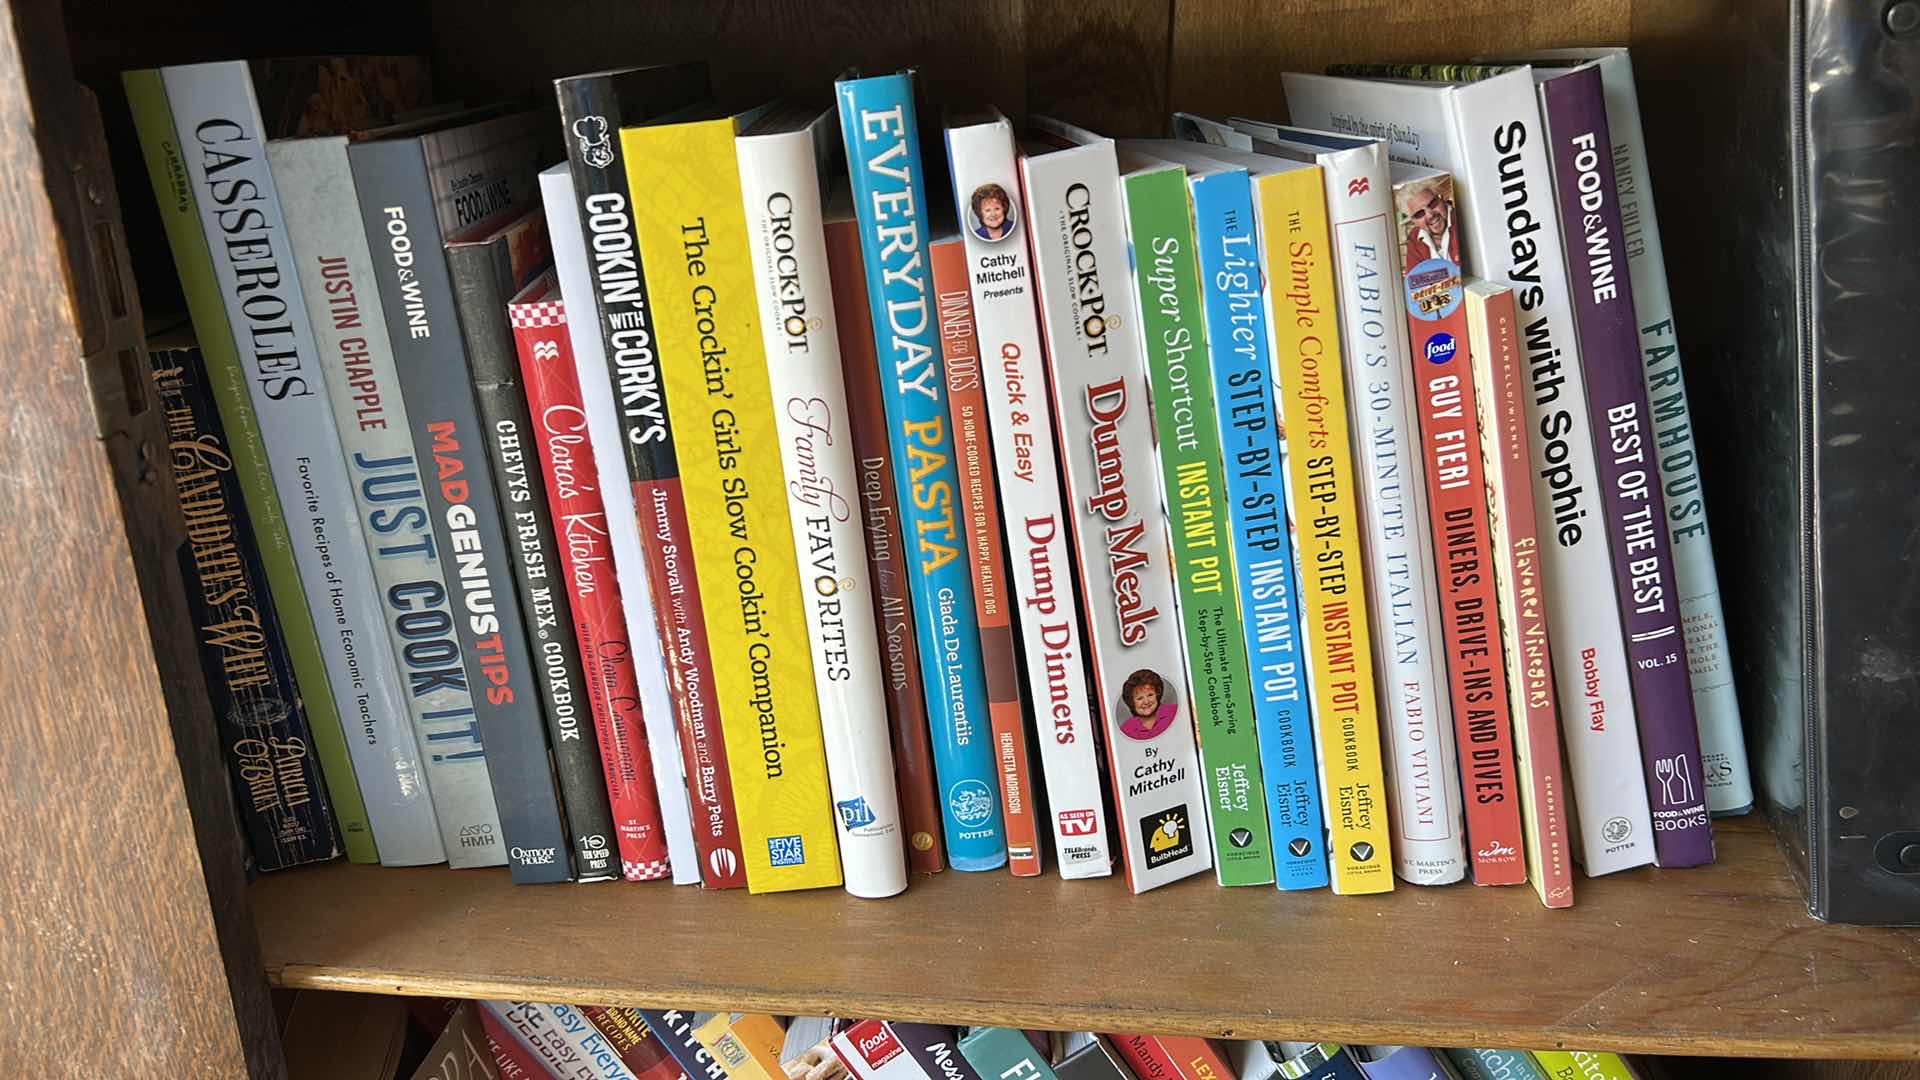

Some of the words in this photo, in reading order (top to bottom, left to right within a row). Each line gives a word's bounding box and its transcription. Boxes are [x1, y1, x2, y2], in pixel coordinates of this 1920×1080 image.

[1358, 117, 1368, 134] the
[1368, 120, 1385, 137] spirit
[1386, 123, 1394, 144] of
[1393, 122, 1420, 149] Sunday
[1613, 144, 1636, 196] NANCY
[1224, 209, 1238, 233] THE
[1287, 211, 1302, 233] THE
[1494, 120, 1545, 312] Sundays
[1572, 132, 1617, 304] FOOD&WINE
[1621, 201, 1645, 259] FULLER
[195, 118, 315, 401] CASSEROLES
[585, 193, 644, 309] COOKIN'
[682, 217, 709, 276] The
[980, 253, 1017, 268] Cathy
[318, 256, 361, 330] JUSTIN
[976, 267, 1025, 285] Mitchell
[983, 286, 1024, 299] Presents
[1147, 237, 1181, 322] Super
[1216, 233, 1260, 361] Lighter
[1286, 241, 1320, 328] Simple
[608, 311, 645, 330] WITH
[939, 291, 973, 339] DINNER
[1354, 242, 1386, 368] FABIO'S
[692, 285, 734, 399] Crockin'
[861, 105, 937, 400] EVERYDAY
[903, 416, 960, 576] PASTA
[1426, 338, 1455, 359] food
[1524, 317, 1565, 406] with
[339, 337, 387, 431] CHAPPLE
[611, 329, 666, 444] CORKY'S
[948, 355, 979, 392] DOGS
[1002, 343, 1027, 405] Quick
[1163, 328, 1199, 452] Shortcut
[1298, 336, 1330, 449] Comforts
[1428, 375, 1463, 419] GUY
[712, 409, 741, 470] Girls
[1011, 411, 1029, 426] &
[1607, 402, 1644, 465] BEST
[1641, 318, 1705, 545] FARMHOUSE
[543, 404, 594, 499] Clara's
[788, 398, 849, 522] Family
[964, 419, 980, 477] HOME-COOKED
[1014, 433, 1034, 484] Easy
[1086, 375, 1129, 521] Dump
[1228, 369, 1280, 552] STEP-BY-STEP
[1369, 382, 1406, 540] 30-MINUTE
[1435, 429, 1470, 490] FIERI
[296, 456, 319, 513] Favorite
[862, 457, 884, 501] Deep
[970, 479, 984, 511] RECIPES
[1176, 461, 1216, 548] INSTANT
[1540, 410, 1587, 547] Sophie
[1617, 470, 1648, 500] OF
[354, 452, 437, 560] JUST
[652, 488, 672, 542] Jimmy
[722, 478, 749, 540] Slow
[1307, 456, 1346, 595] STEP-BY-STEP
[1622, 504, 1656, 555] THE
[311, 517, 332, 568] Recipes
[561, 511, 607, 598] Kitchen
[867, 507, 892, 560] Frying
[1444, 507, 1480, 593] DINERS,
[325, 571, 342, 583] of
[497, 420, 530, 503] CHEVYS
[515, 510, 547, 580] FRESH
[543, 642, 580, 742] COOKBOOK
[663, 545, 684, 595] Stovall
[980, 565, 995, 597] HEALTHY
[1025, 514, 1056, 614] Dump
[1107, 519, 1159, 646] Meals
[1189, 556, 1222, 593] POT
[1630, 556, 1665, 614] BEST
[329, 587, 347, 625] Home
[672, 599, 687, 624] with
[734, 546, 769, 638] Cookin'
[806, 516, 850, 681] FAVORITES
[881, 595, 904, 617] All
[938, 588, 958, 635] Giada
[1213, 606, 1223, 625] The
[1249, 559, 1294, 653] INSTANT
[1387, 552, 1418, 664] ITALIAN
[201, 605, 272, 691] WIFE
[341, 629, 363, 689] Economic
[388, 580, 468, 698] COOK
[677, 628, 695, 665] Andy
[886, 622, 908, 691] Seasons
[944, 638, 960, 662] De
[1216, 627, 1230, 672] Ultimate
[1322, 601, 1356, 674] INSTANT
[1455, 598, 1493, 703] DRIVE-INS
[1638, 657, 1664, 669] VOL.
[1040, 620, 1075, 745] Dinners
[1198, 609, 1214, 675] Step-by-Step
[1208, 677, 1222, 727] Cookbook
[1262, 662, 1299, 702] POT
[1581, 648, 1601, 698] Bobby
[357, 693, 377, 745] Teachers
[685, 667, 704, 739] Woodman
[749, 643, 785, 778] Companion
[948, 663, 972, 746] Laurentiis
[1222, 673, 1237, 735] Time-Saving
[1331, 681, 1359, 712] POT
[1403, 680, 1425, 742] FABIO
[1589, 700, 1605, 732] Flay
[422, 708, 486, 763] IT!
[1278, 709, 1297, 768] COOKBOOK
[1342, 717, 1360, 771] COOKBOOK
[1467, 709, 1497, 743] AND
[1000, 732, 1017, 773] HENRIETTA
[1134, 758, 1176, 779] Cathy
[1145, 747, 1158, 758] By
[1472, 748, 1504, 805] DIVES
[702, 766, 717, 802] Barry
[1005, 774, 1022, 814] MORRISON
[1129, 768, 1185, 797] Mitchell
[1216, 767, 1232, 811] Eisner
[1232, 763, 1248, 811] Jeffrey
[1277, 783, 1293, 828] Eisner
[1294, 779, 1309, 827] Jeffrey
[1339, 786, 1354, 831] Eisner
[1356, 783, 1372, 831] Jeffrey
[1411, 749, 1434, 825] VIVIANI
[620, 824, 650, 832] MARTIN'S
[708, 805, 724, 836] Pelts
[841, 797, 870, 826] pil
[959, 829, 994, 839] POTTER
[1060, 817, 1094, 833] TV
[1654, 813, 1707, 831] BOOKS
[460, 835, 495, 848] HMH
[511, 847, 556, 859] Oxmoor
[1150, 846, 1188, 864] BulbHead
[1416, 857, 1456, 867] MARTIN'S
[1605, 842, 1636, 853] POTTER
[596, 1014, 632, 1052] RECIPES
[606, 1008, 627, 1028] BRAND
[622, 1025, 642, 1046] NAME
[860, 1025, 888, 1057] food
[496, 1053, 522, 1079] LIKE
[871, 1047, 902, 1069] magazine
